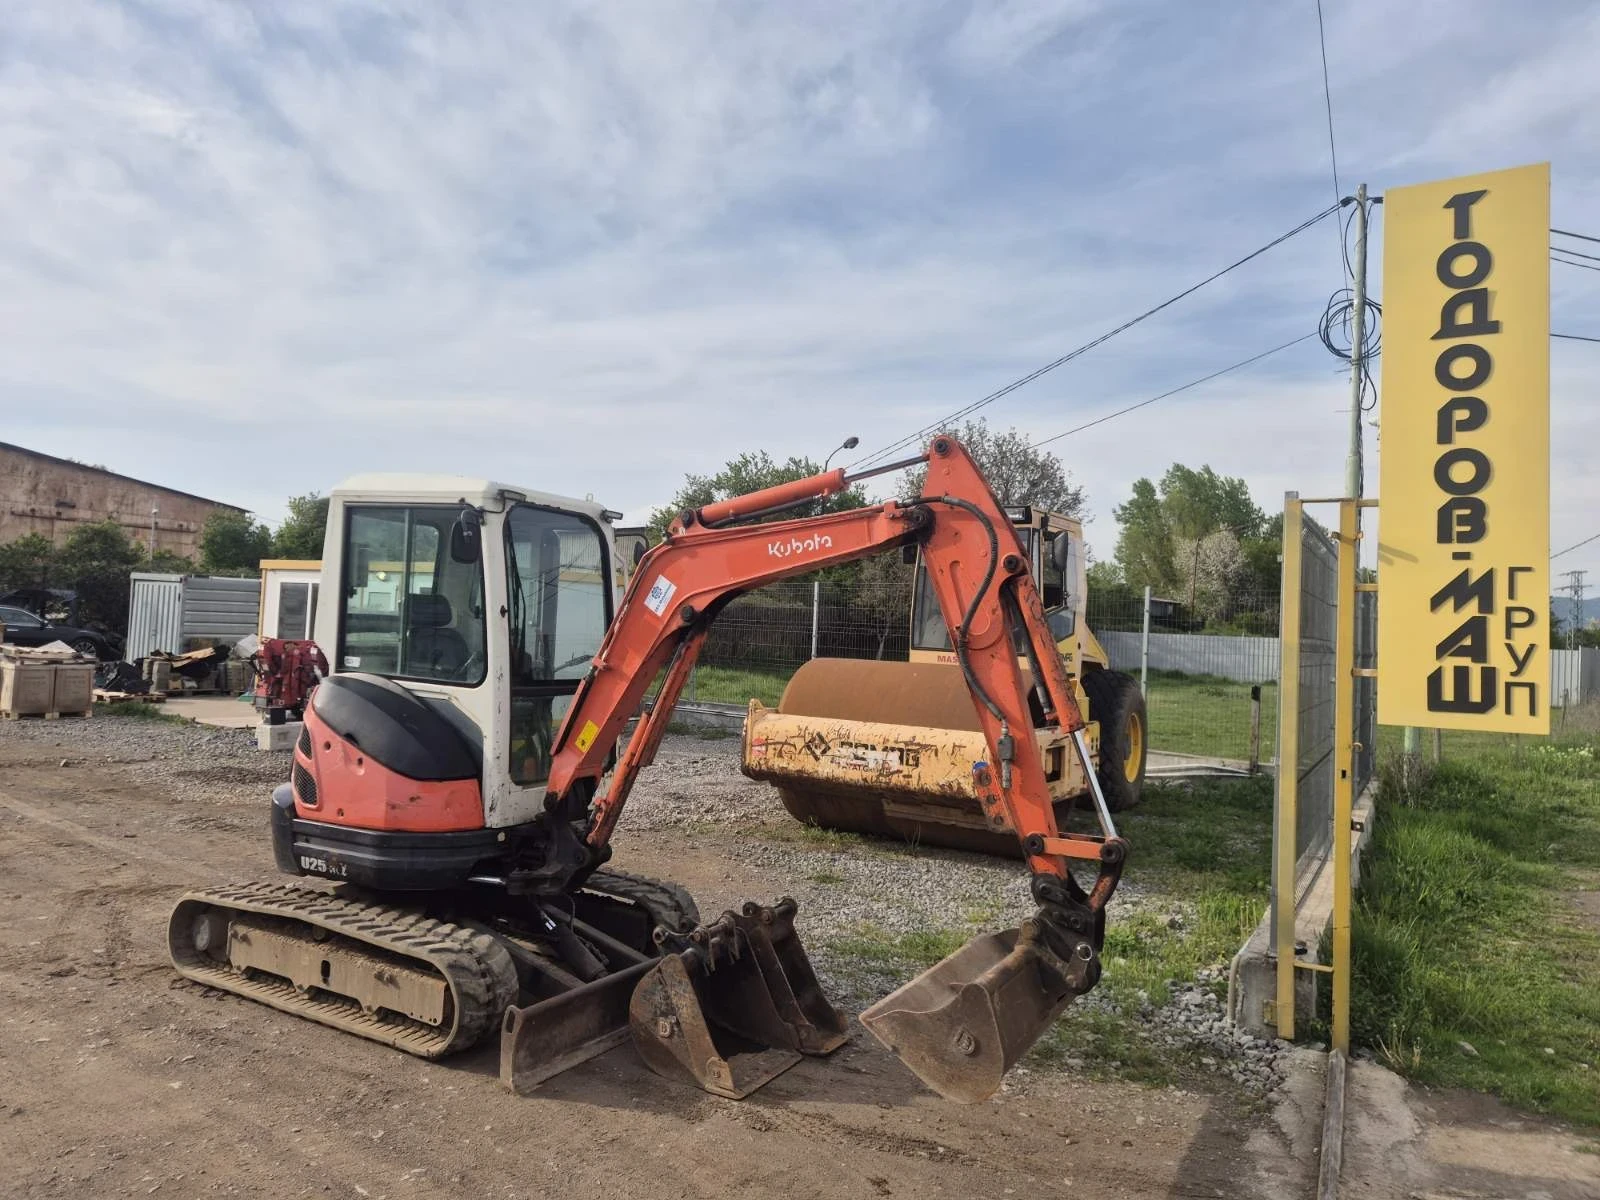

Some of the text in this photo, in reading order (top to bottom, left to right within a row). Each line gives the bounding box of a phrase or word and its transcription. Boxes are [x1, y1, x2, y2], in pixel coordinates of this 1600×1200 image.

[768, 533, 832, 558] Kubota
[1504, 566, 1537, 717] ГРУП
[300, 855, 327, 873] U25
